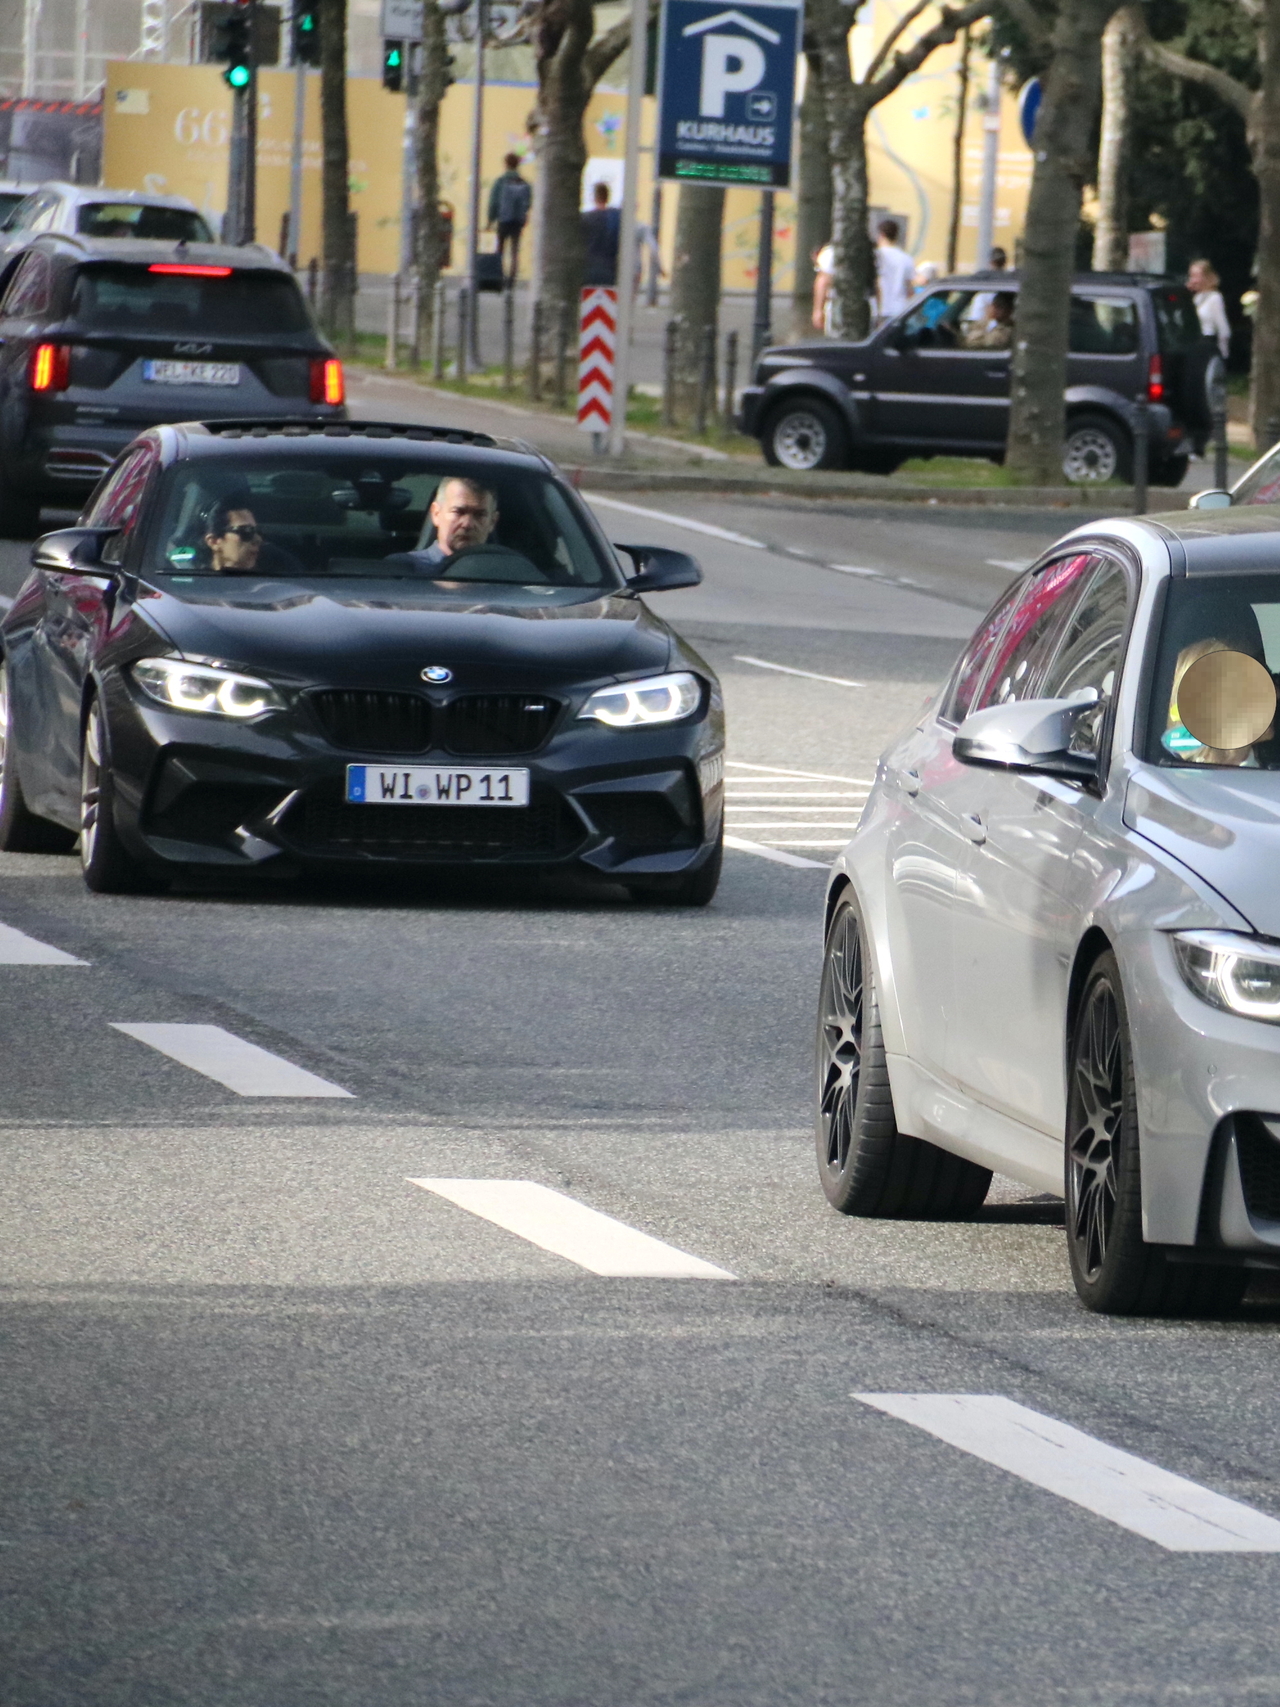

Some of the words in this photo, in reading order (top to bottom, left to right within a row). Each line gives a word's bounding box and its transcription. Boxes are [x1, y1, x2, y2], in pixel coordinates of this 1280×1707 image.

[700, 33, 766, 118] P
[676, 121, 775, 146] KURHAUS
[380, 772, 413, 799] WI
